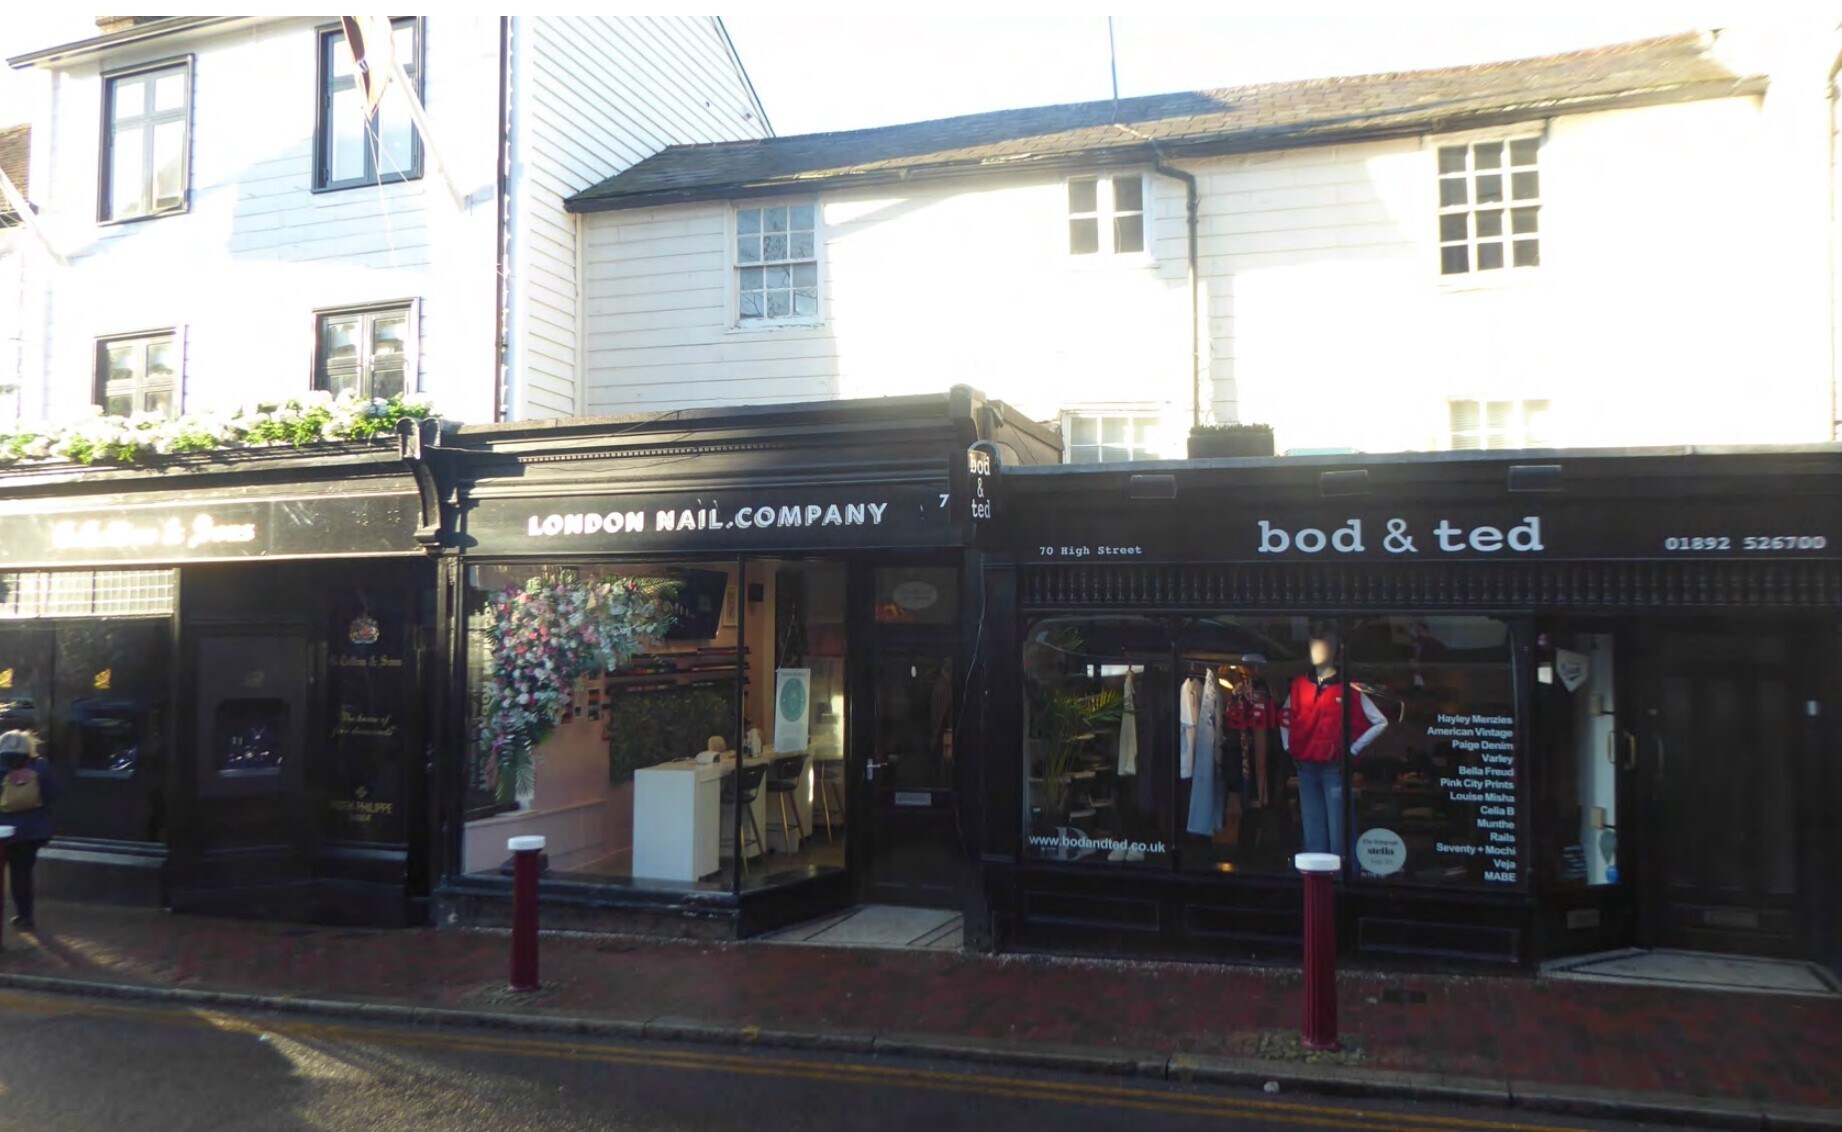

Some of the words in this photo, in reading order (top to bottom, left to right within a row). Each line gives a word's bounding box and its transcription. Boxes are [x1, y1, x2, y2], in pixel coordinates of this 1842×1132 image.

[970, 456, 991, 476] bod
[976, 477, 985, 498] &
[971, 499, 991, 519] ted
[528, 511, 645, 537] LONDON
[1257, 518, 1366, 554] bod
[1382, 517, 1419, 554] &
[1432, 516, 1545, 552] ted
[1664, 536, 1731, 550] 01892
[1743, 535, 1827, 550] 526700
[1039, 546, 1054, 556] 70
[1060, 546, 1090, 557] High
[1097, 545, 1142, 555] Street
[1437, 714, 1471, 725] Hayley
[1471, 715, 1514, 724] Menzies
[1427, 726, 1474, 736] American
[1475, 727, 1513, 739] Vintage
[1452, 740, 1480, 751] Paige
[1481, 741, 1514, 750] Denim
[1481, 754, 1514, 765] Varley
[1458, 766, 1483, 775] Bella
[1484, 767, 1515, 776] Freud
[1440, 778, 1462, 787] Pink
[1463, 779, 1483, 790] City
[1484, 780, 1515, 789] Prints
[1450, 792, 1484, 801] Louise
[1484, 793, 1516, 802] Misha
[1480, 806, 1505, 816] Celia
[1506, 807, 1515, 816] B
[1477, 819, 1515, 829] Munthe
[1489, 832, 1516, 843] Rails
[1029, 835, 1166, 854] www.bodandted.co.uk
[1436, 843, 1475, 855] Seventy
[1485, 846, 1516, 855] Mochi
[1367, 846, 1395, 856] stella
[1493, 859, 1516, 870] Veja
[1484, 871, 1517, 882] MABE
